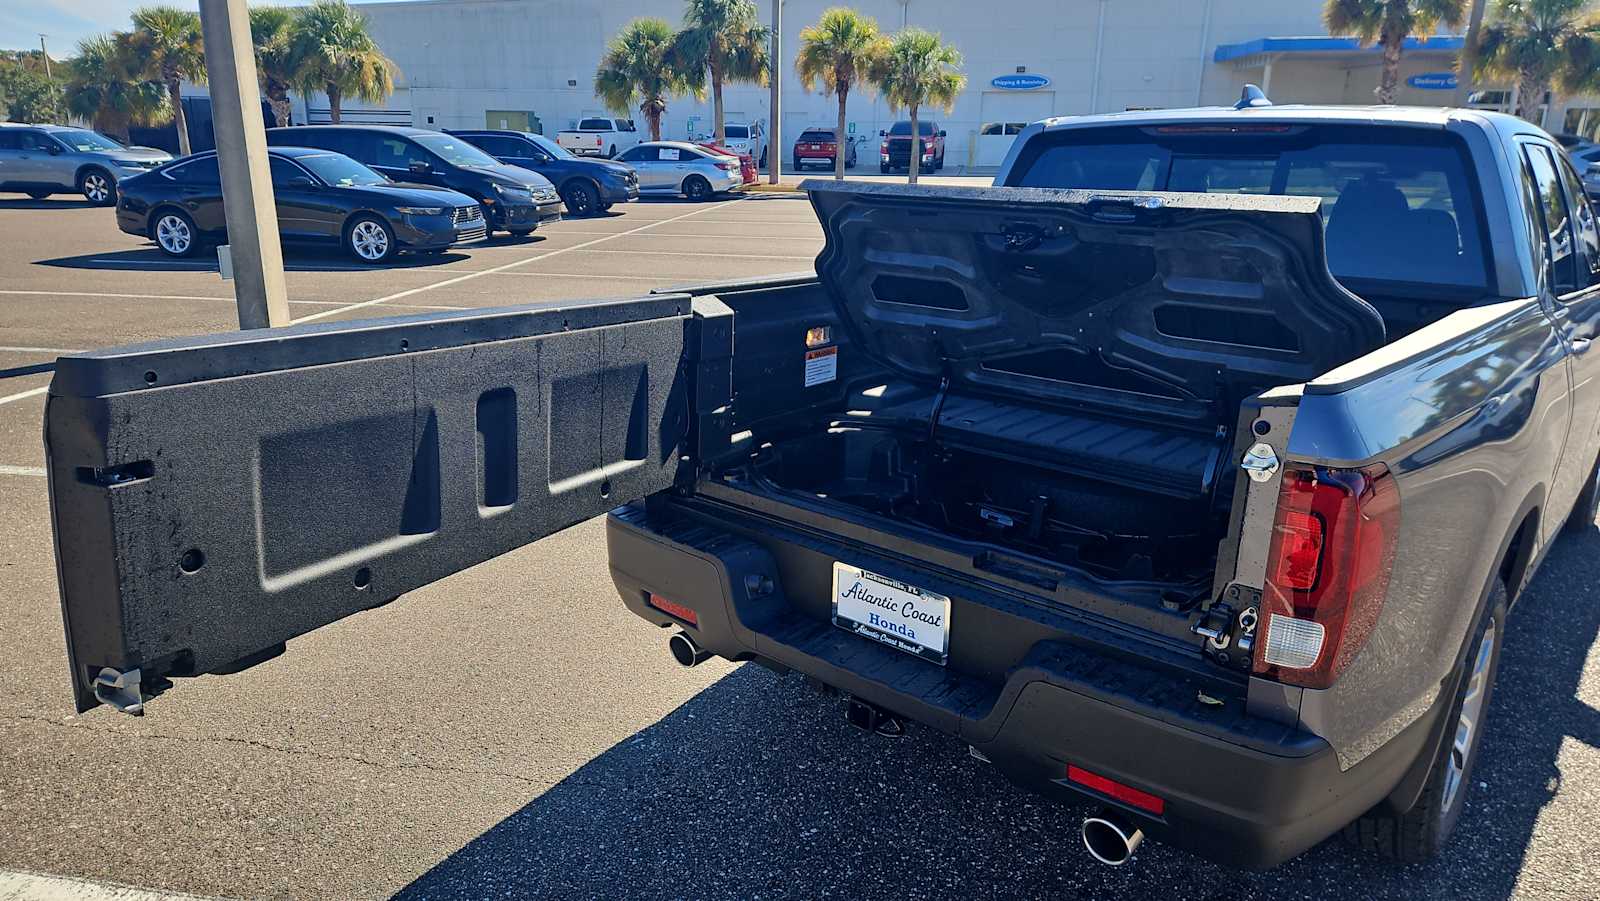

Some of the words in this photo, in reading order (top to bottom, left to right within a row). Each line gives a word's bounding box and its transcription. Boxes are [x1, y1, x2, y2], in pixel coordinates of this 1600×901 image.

[1414, 77, 1445, 87] Delivery
[842, 582, 898, 612] Atlantic
[901, 602, 942, 626] Coast
[868, 613, 916, 639] Honda
[855, 626, 880, 639] Atlantic
[879, 634, 898, 645] Coast
[898, 640, 919, 654] Honda
